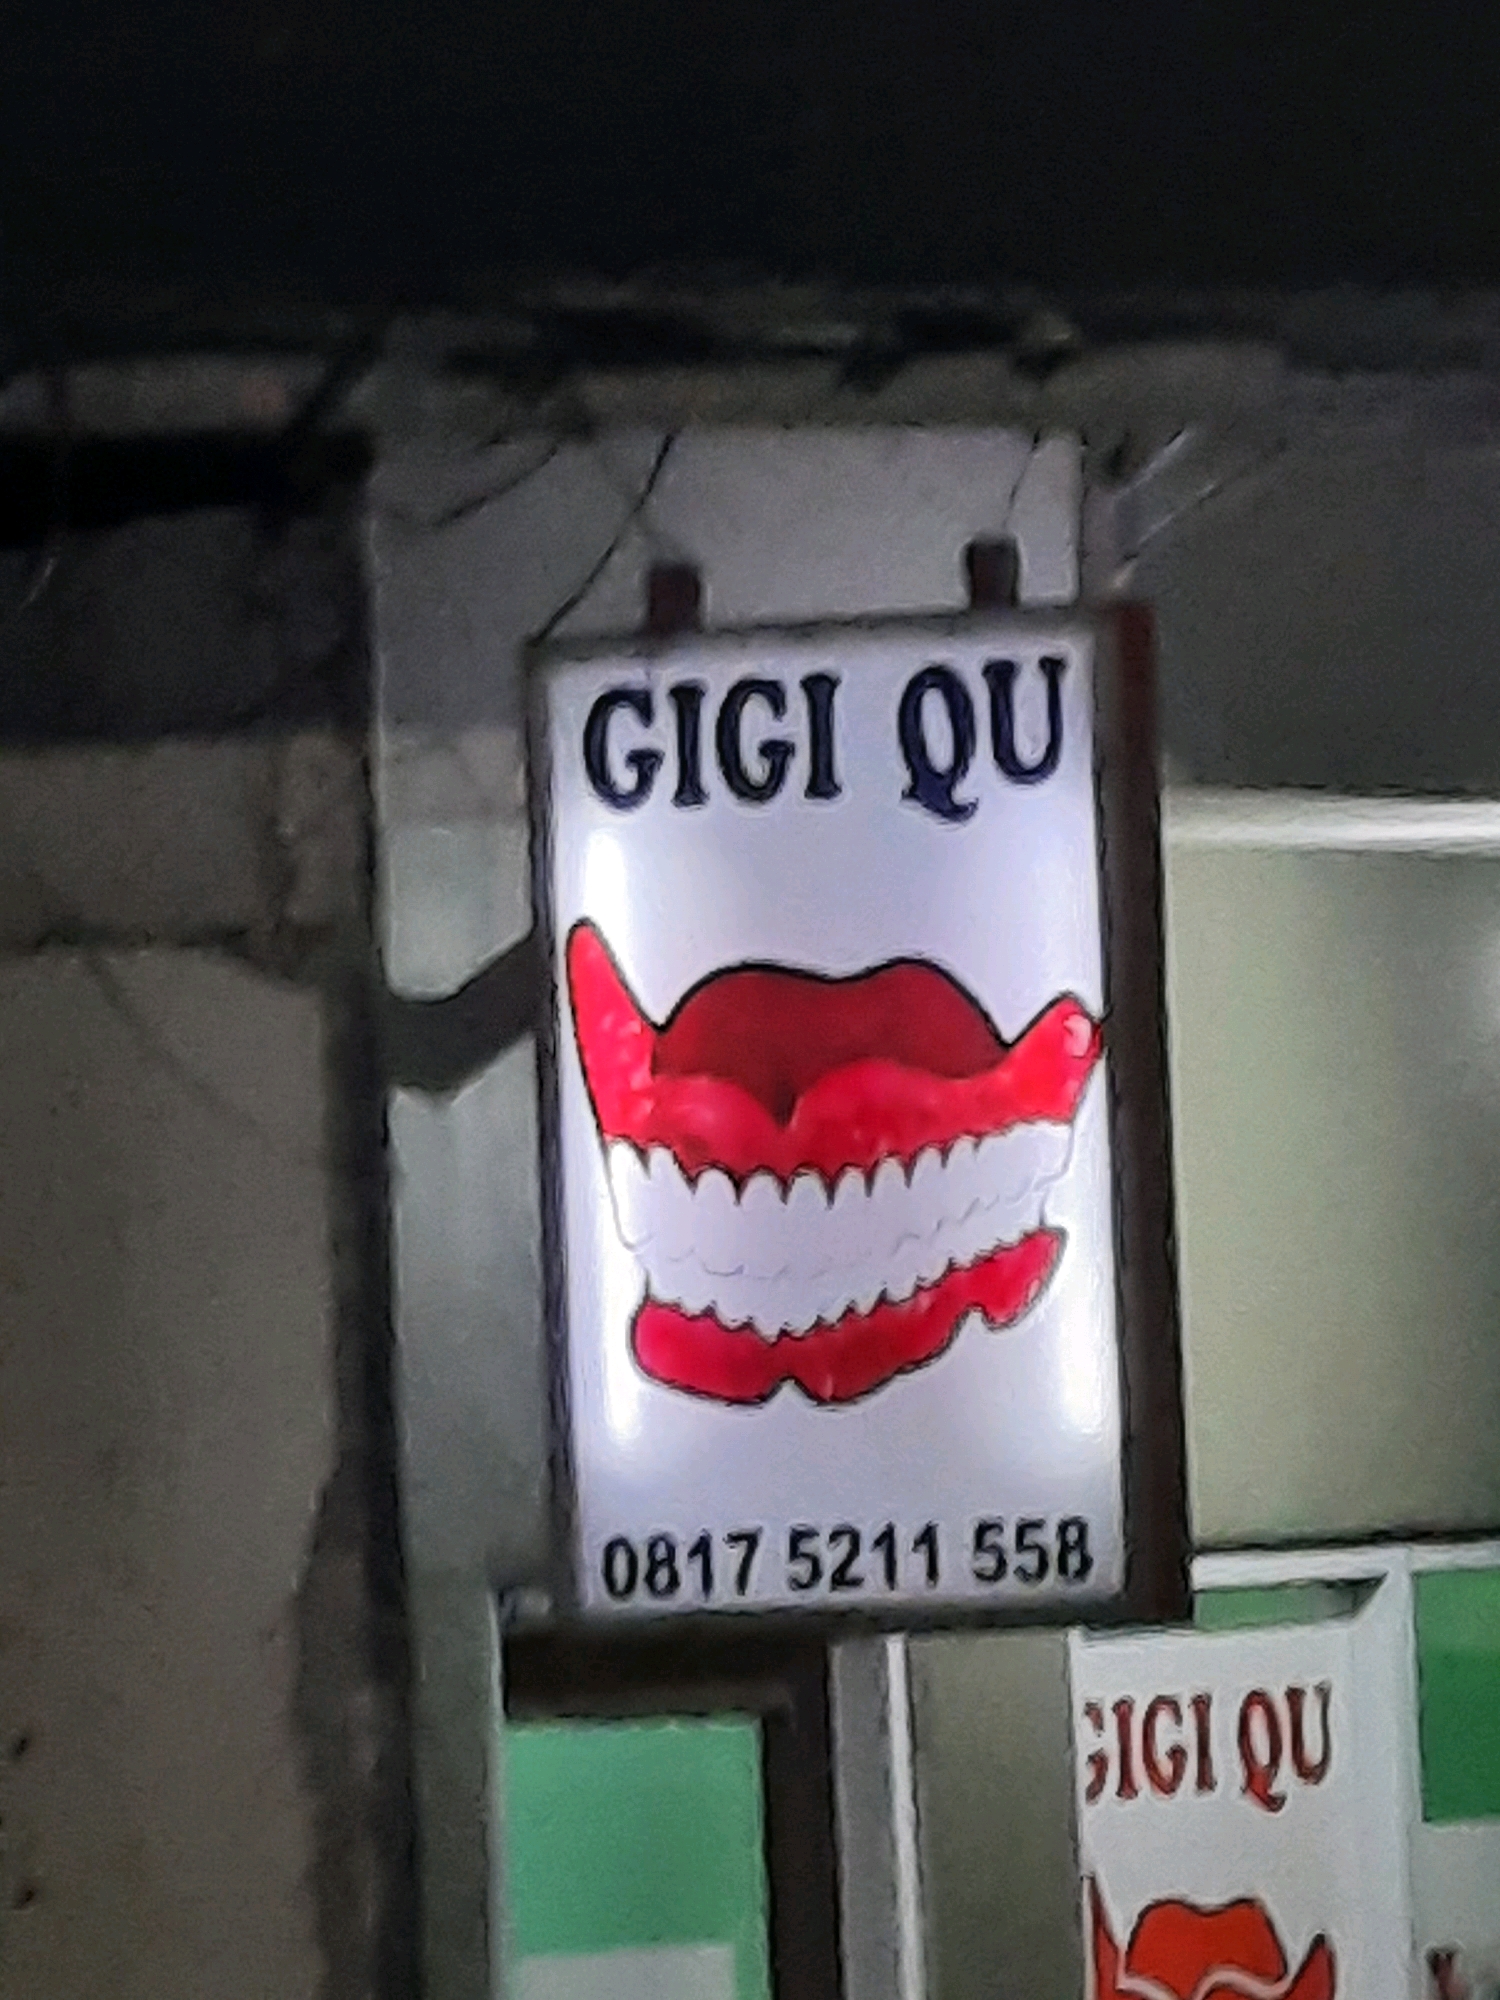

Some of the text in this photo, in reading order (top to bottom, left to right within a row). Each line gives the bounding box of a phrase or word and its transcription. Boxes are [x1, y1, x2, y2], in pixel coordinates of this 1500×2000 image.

[583, 656, 1067, 822] GIGI QU
[601, 1514, 1094, 1600] 0817 5211 558
[1237, 1679, 1332, 1813] QU
